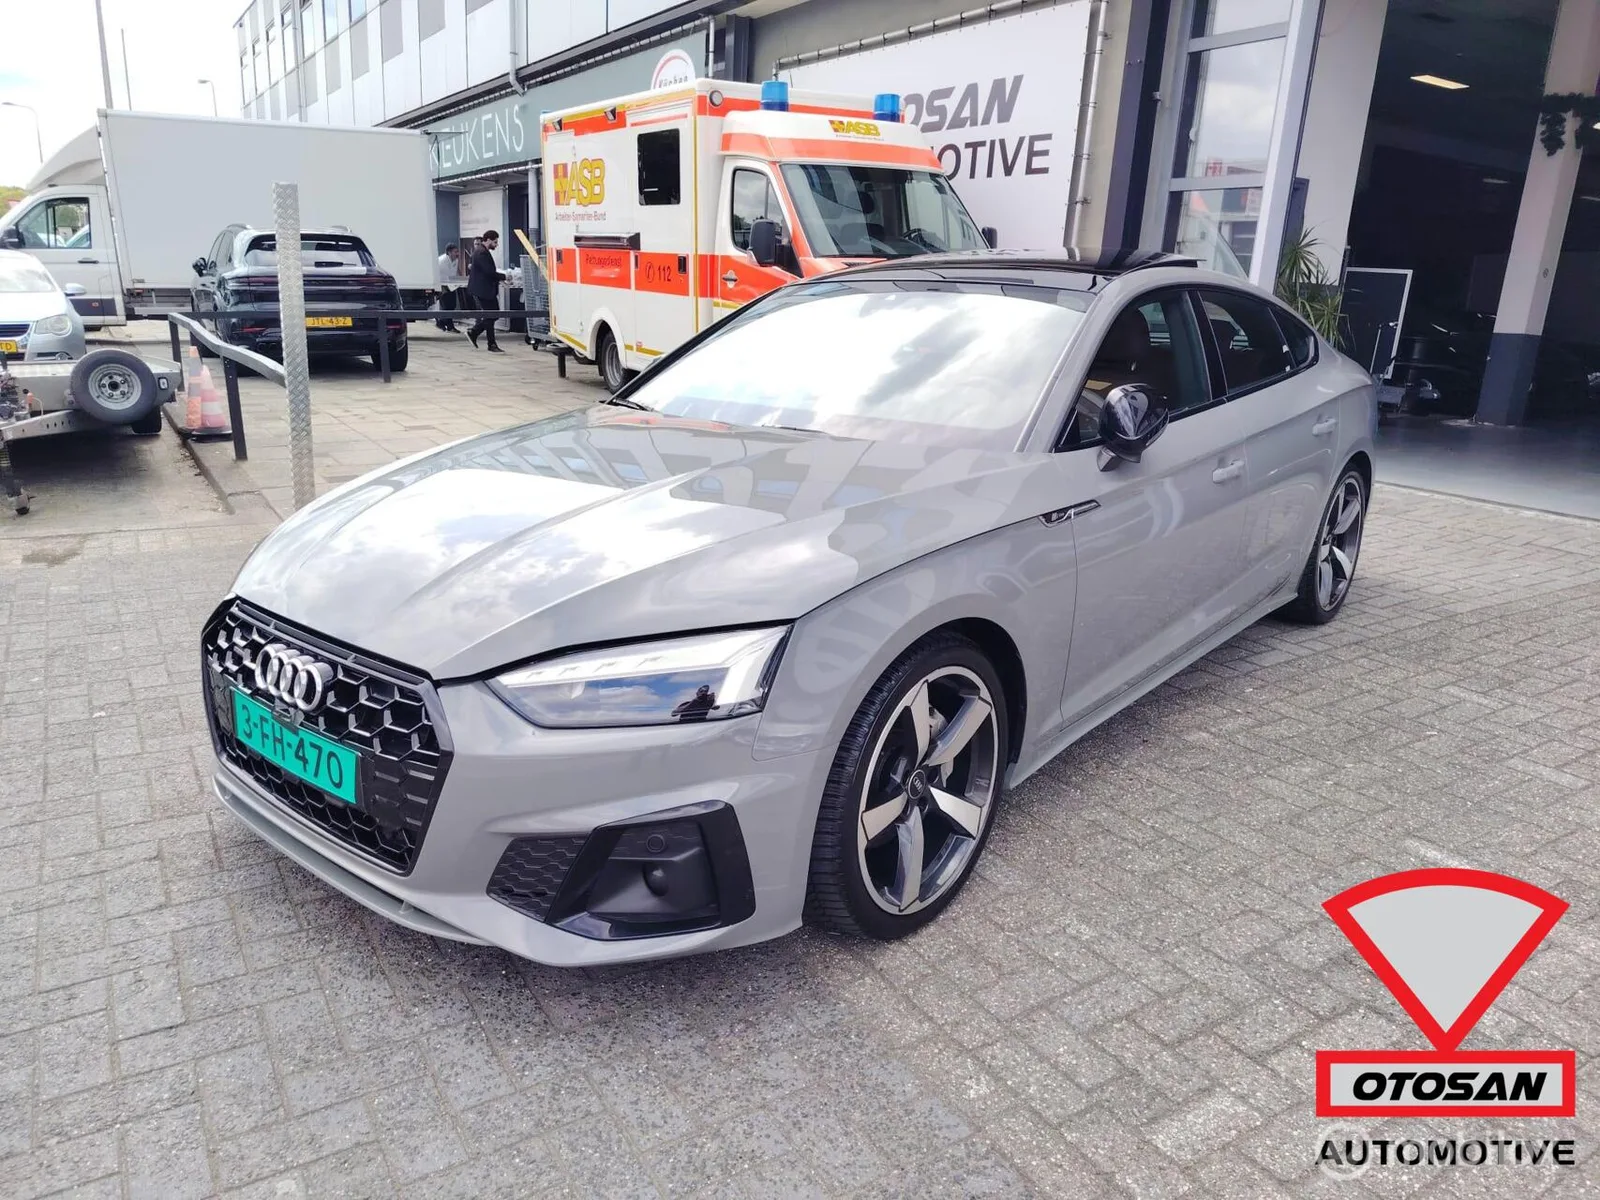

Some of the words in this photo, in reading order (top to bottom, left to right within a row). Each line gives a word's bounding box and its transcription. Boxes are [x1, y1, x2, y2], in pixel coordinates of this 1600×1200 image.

[932, 133, 1053, 181] OTIVE
[566, 158, 605, 207] ASB
[657, 265, 671, 282] 112
